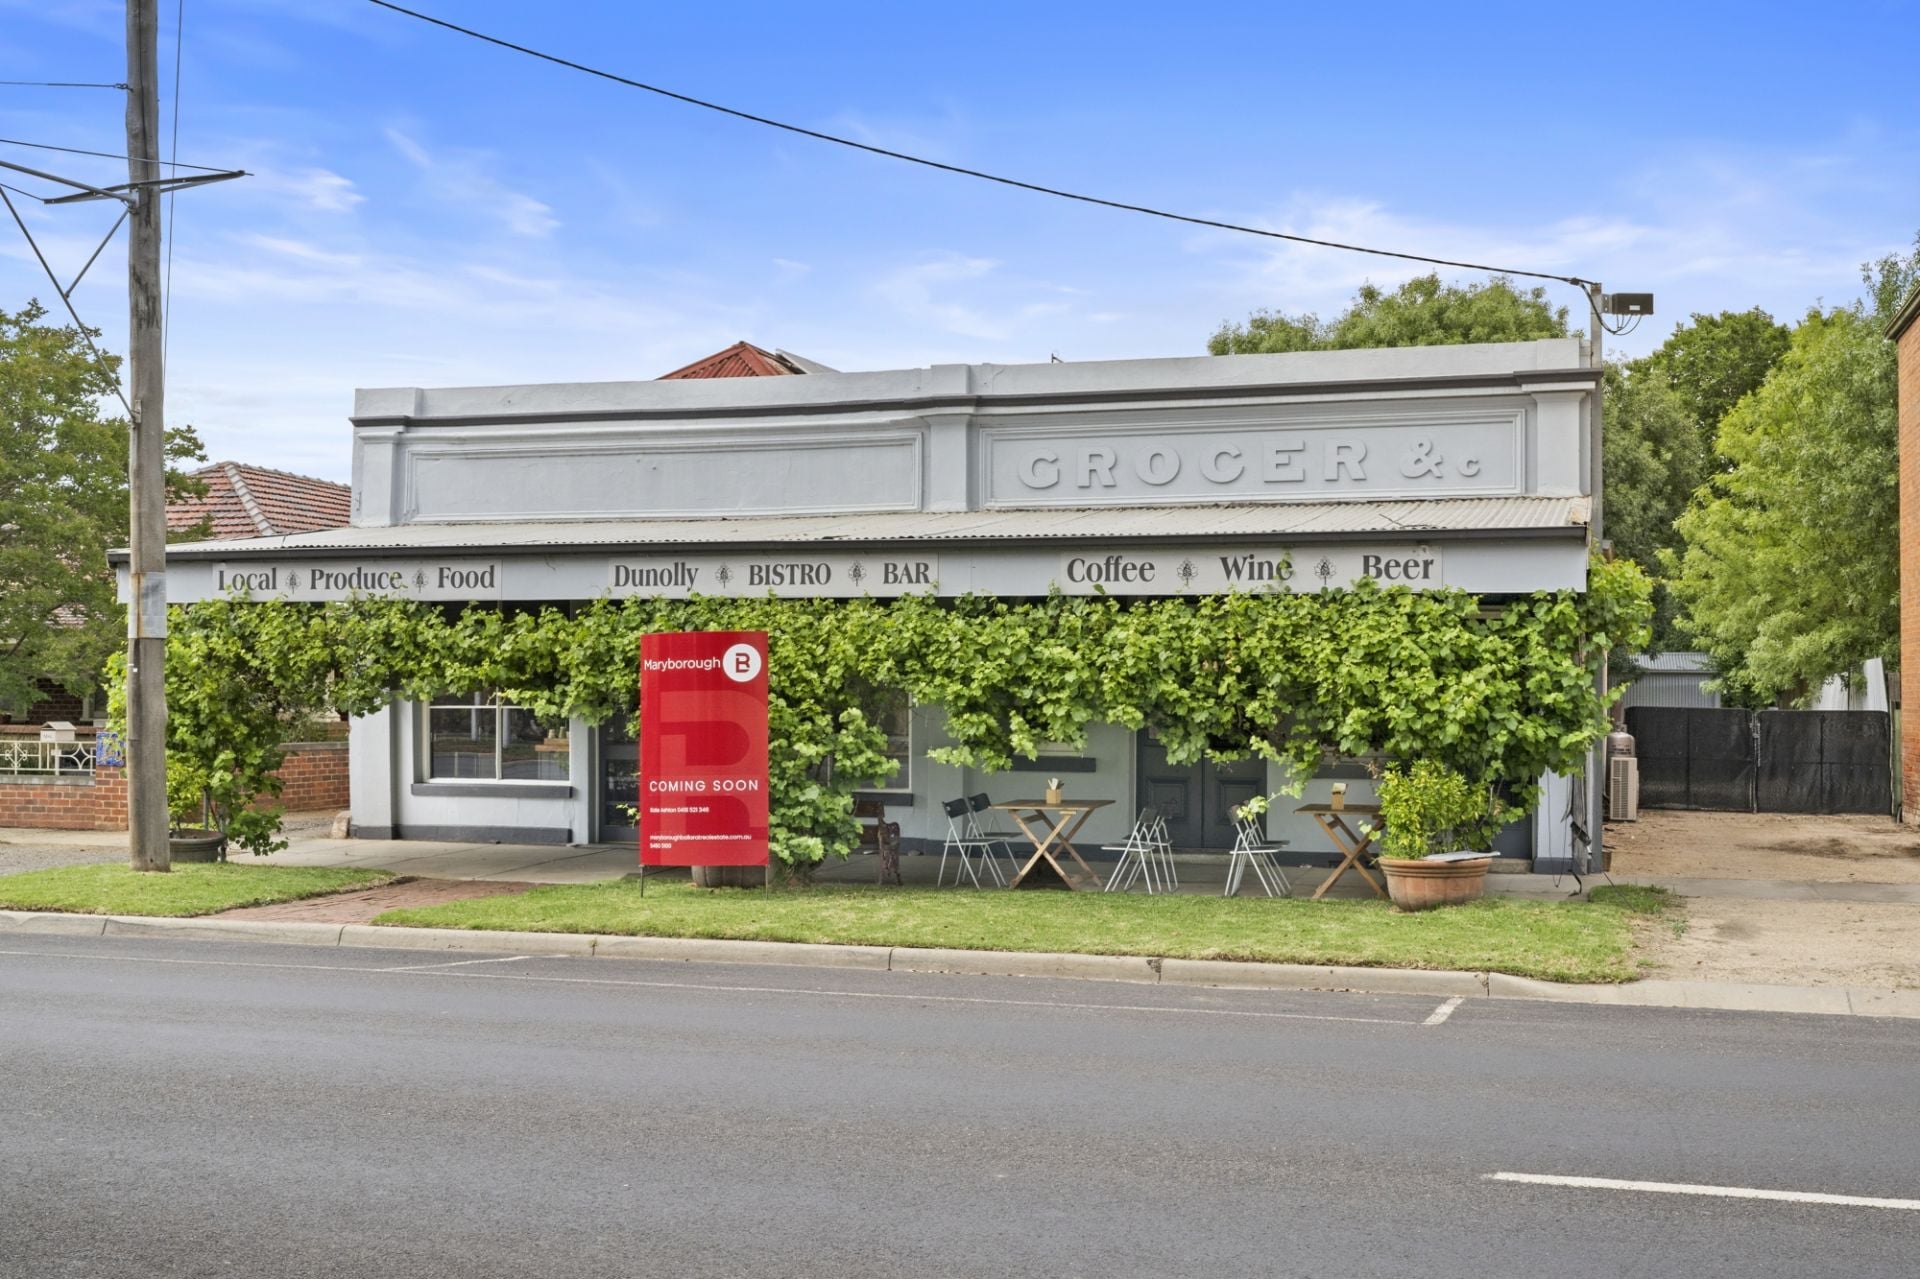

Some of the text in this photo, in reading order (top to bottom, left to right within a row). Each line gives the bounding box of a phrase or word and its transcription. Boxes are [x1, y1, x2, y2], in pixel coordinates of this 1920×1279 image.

[1018, 438, 1368, 489] GROCER
[218, 565, 496, 591] Local Produce Food
[614, 561, 931, 592] Dunolly BISTRO BAR
[1066, 553, 1435, 583] Coffee Wine Beer
[643, 656, 721, 672] Maryborough
[649, 779, 759, 793] COMING SOON
